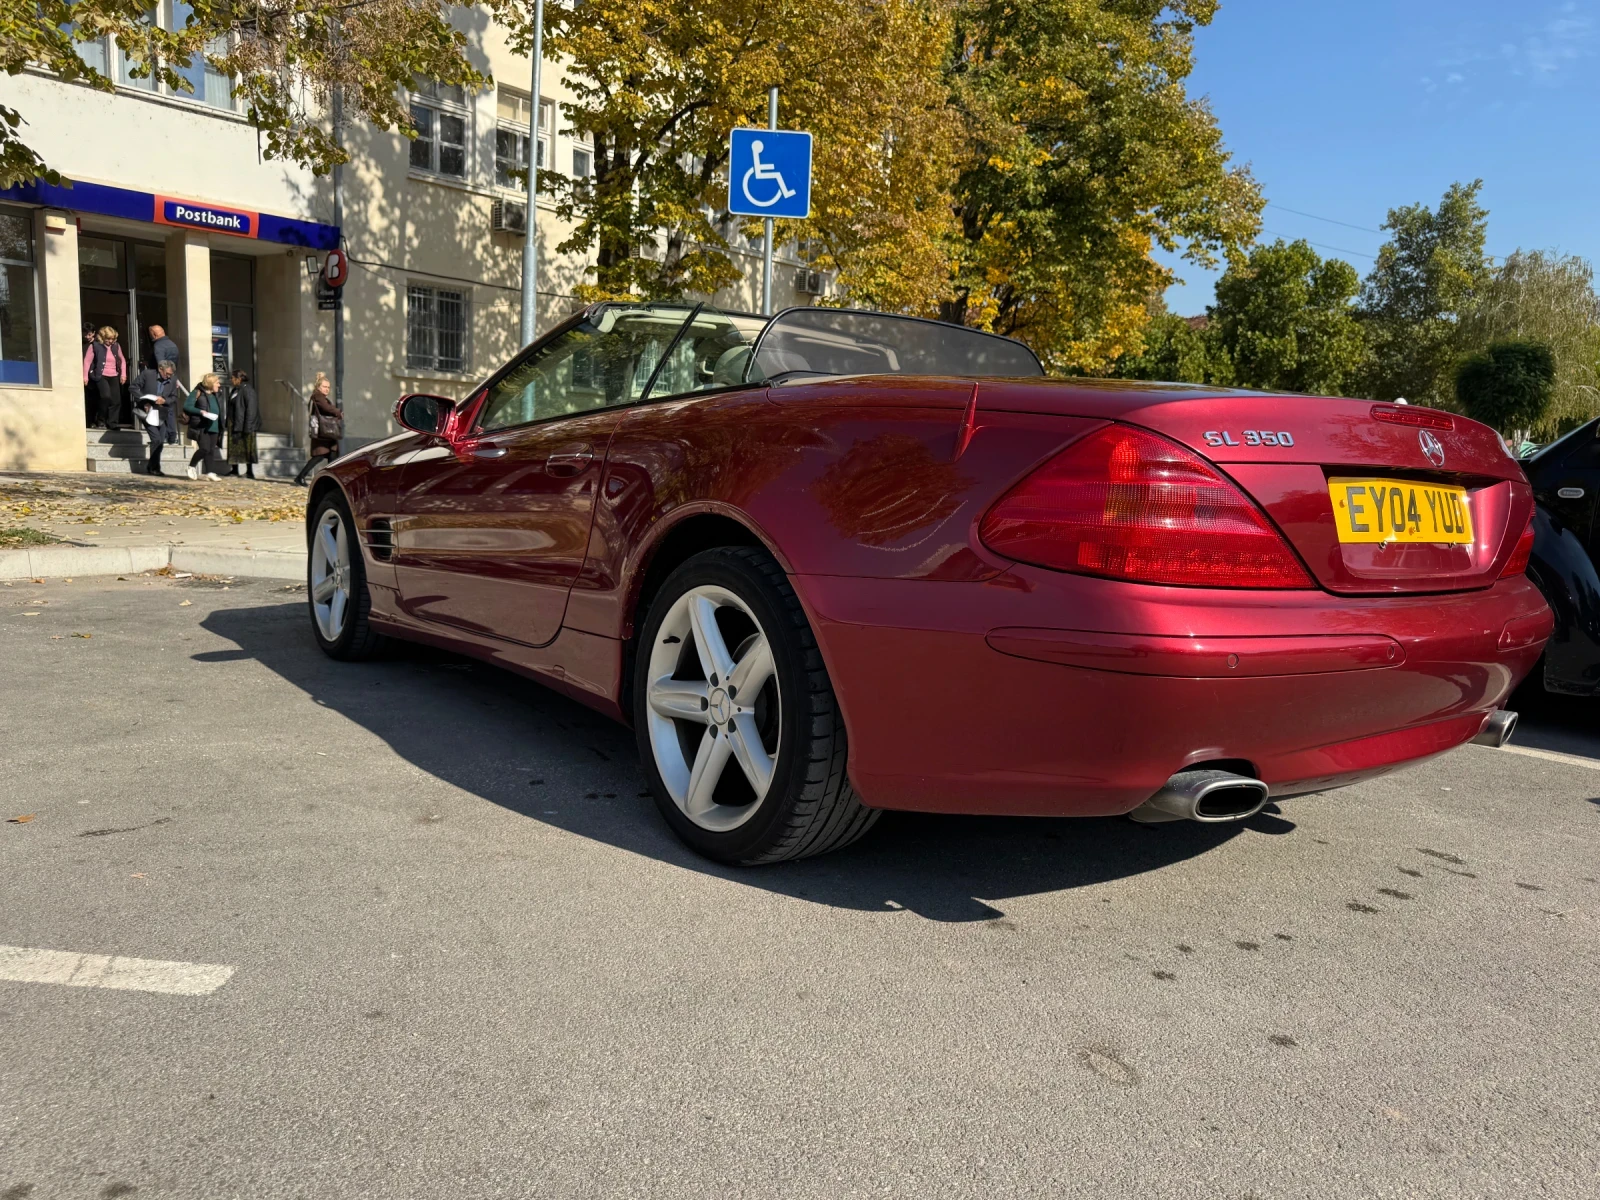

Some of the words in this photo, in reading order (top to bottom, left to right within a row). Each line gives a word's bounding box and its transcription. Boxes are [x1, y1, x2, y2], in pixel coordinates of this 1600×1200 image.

[176, 206, 241, 229] Postbank
[1203, 430, 1240, 446] SL
[1242, 429, 1294, 447] 350
[1346, 486, 1422, 533] EY04
[1424, 489, 1465, 534] YUD
